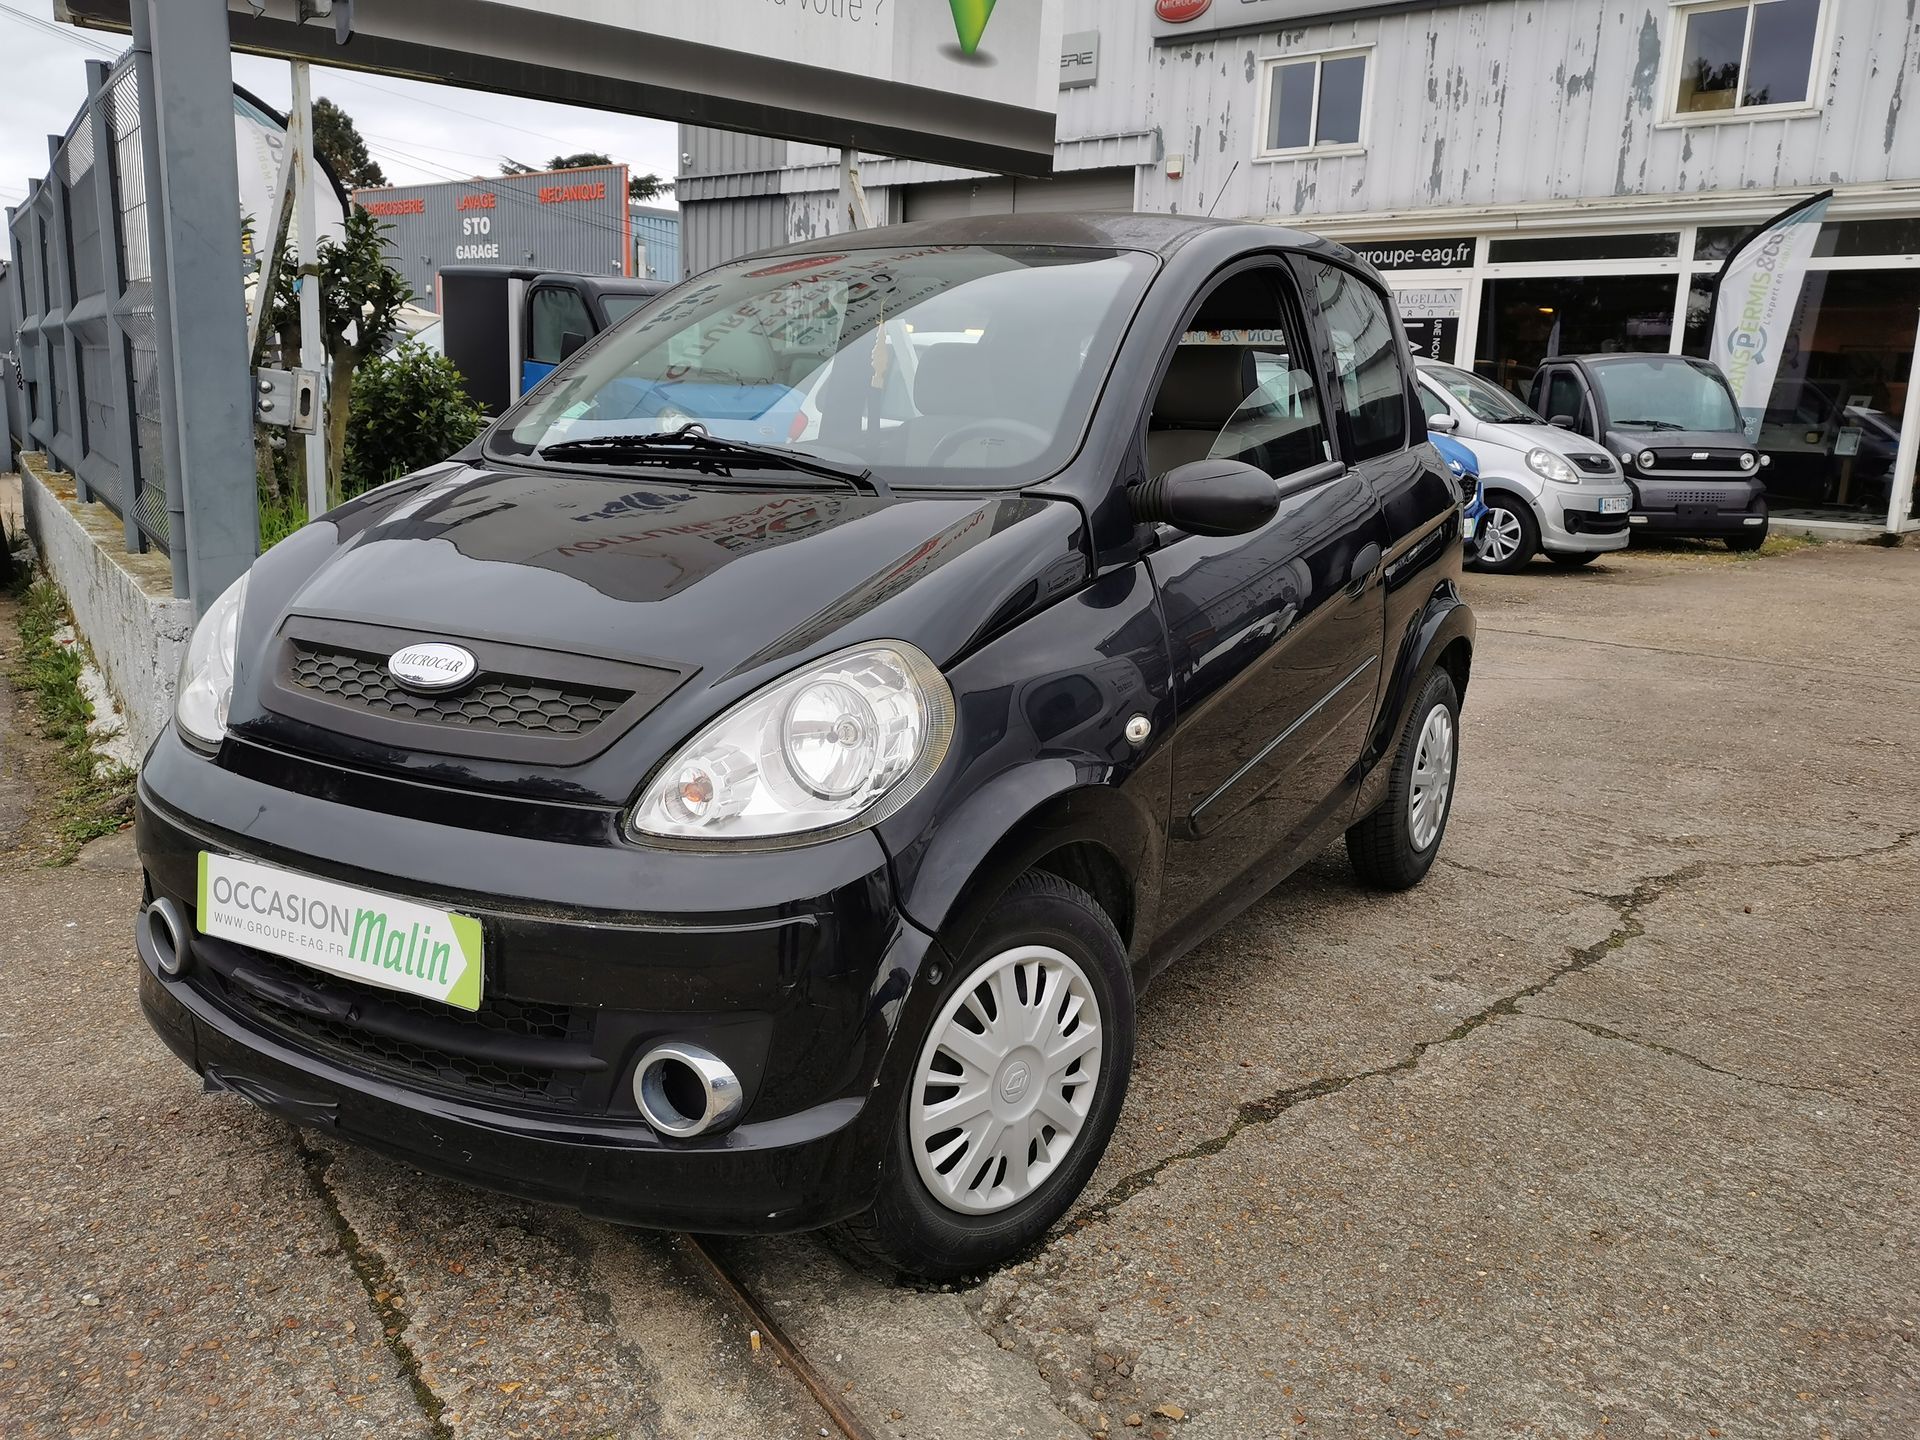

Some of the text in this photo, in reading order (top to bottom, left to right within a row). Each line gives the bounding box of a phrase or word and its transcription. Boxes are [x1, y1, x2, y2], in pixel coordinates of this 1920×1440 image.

[1162, 0, 1201, 9] MICROC
[456, 193, 496, 211] LAVAGE
[538, 182, 606, 204] MECANIQUE
[463, 216, 491, 236] STO
[456, 243, 499, 259] GARAGE
[396, 653, 463, 673] MICROCAR
[213, 876, 451, 985] OCCASION Malin
[214, 911, 344, 957] WWW.GROUPE-EAG.FR
